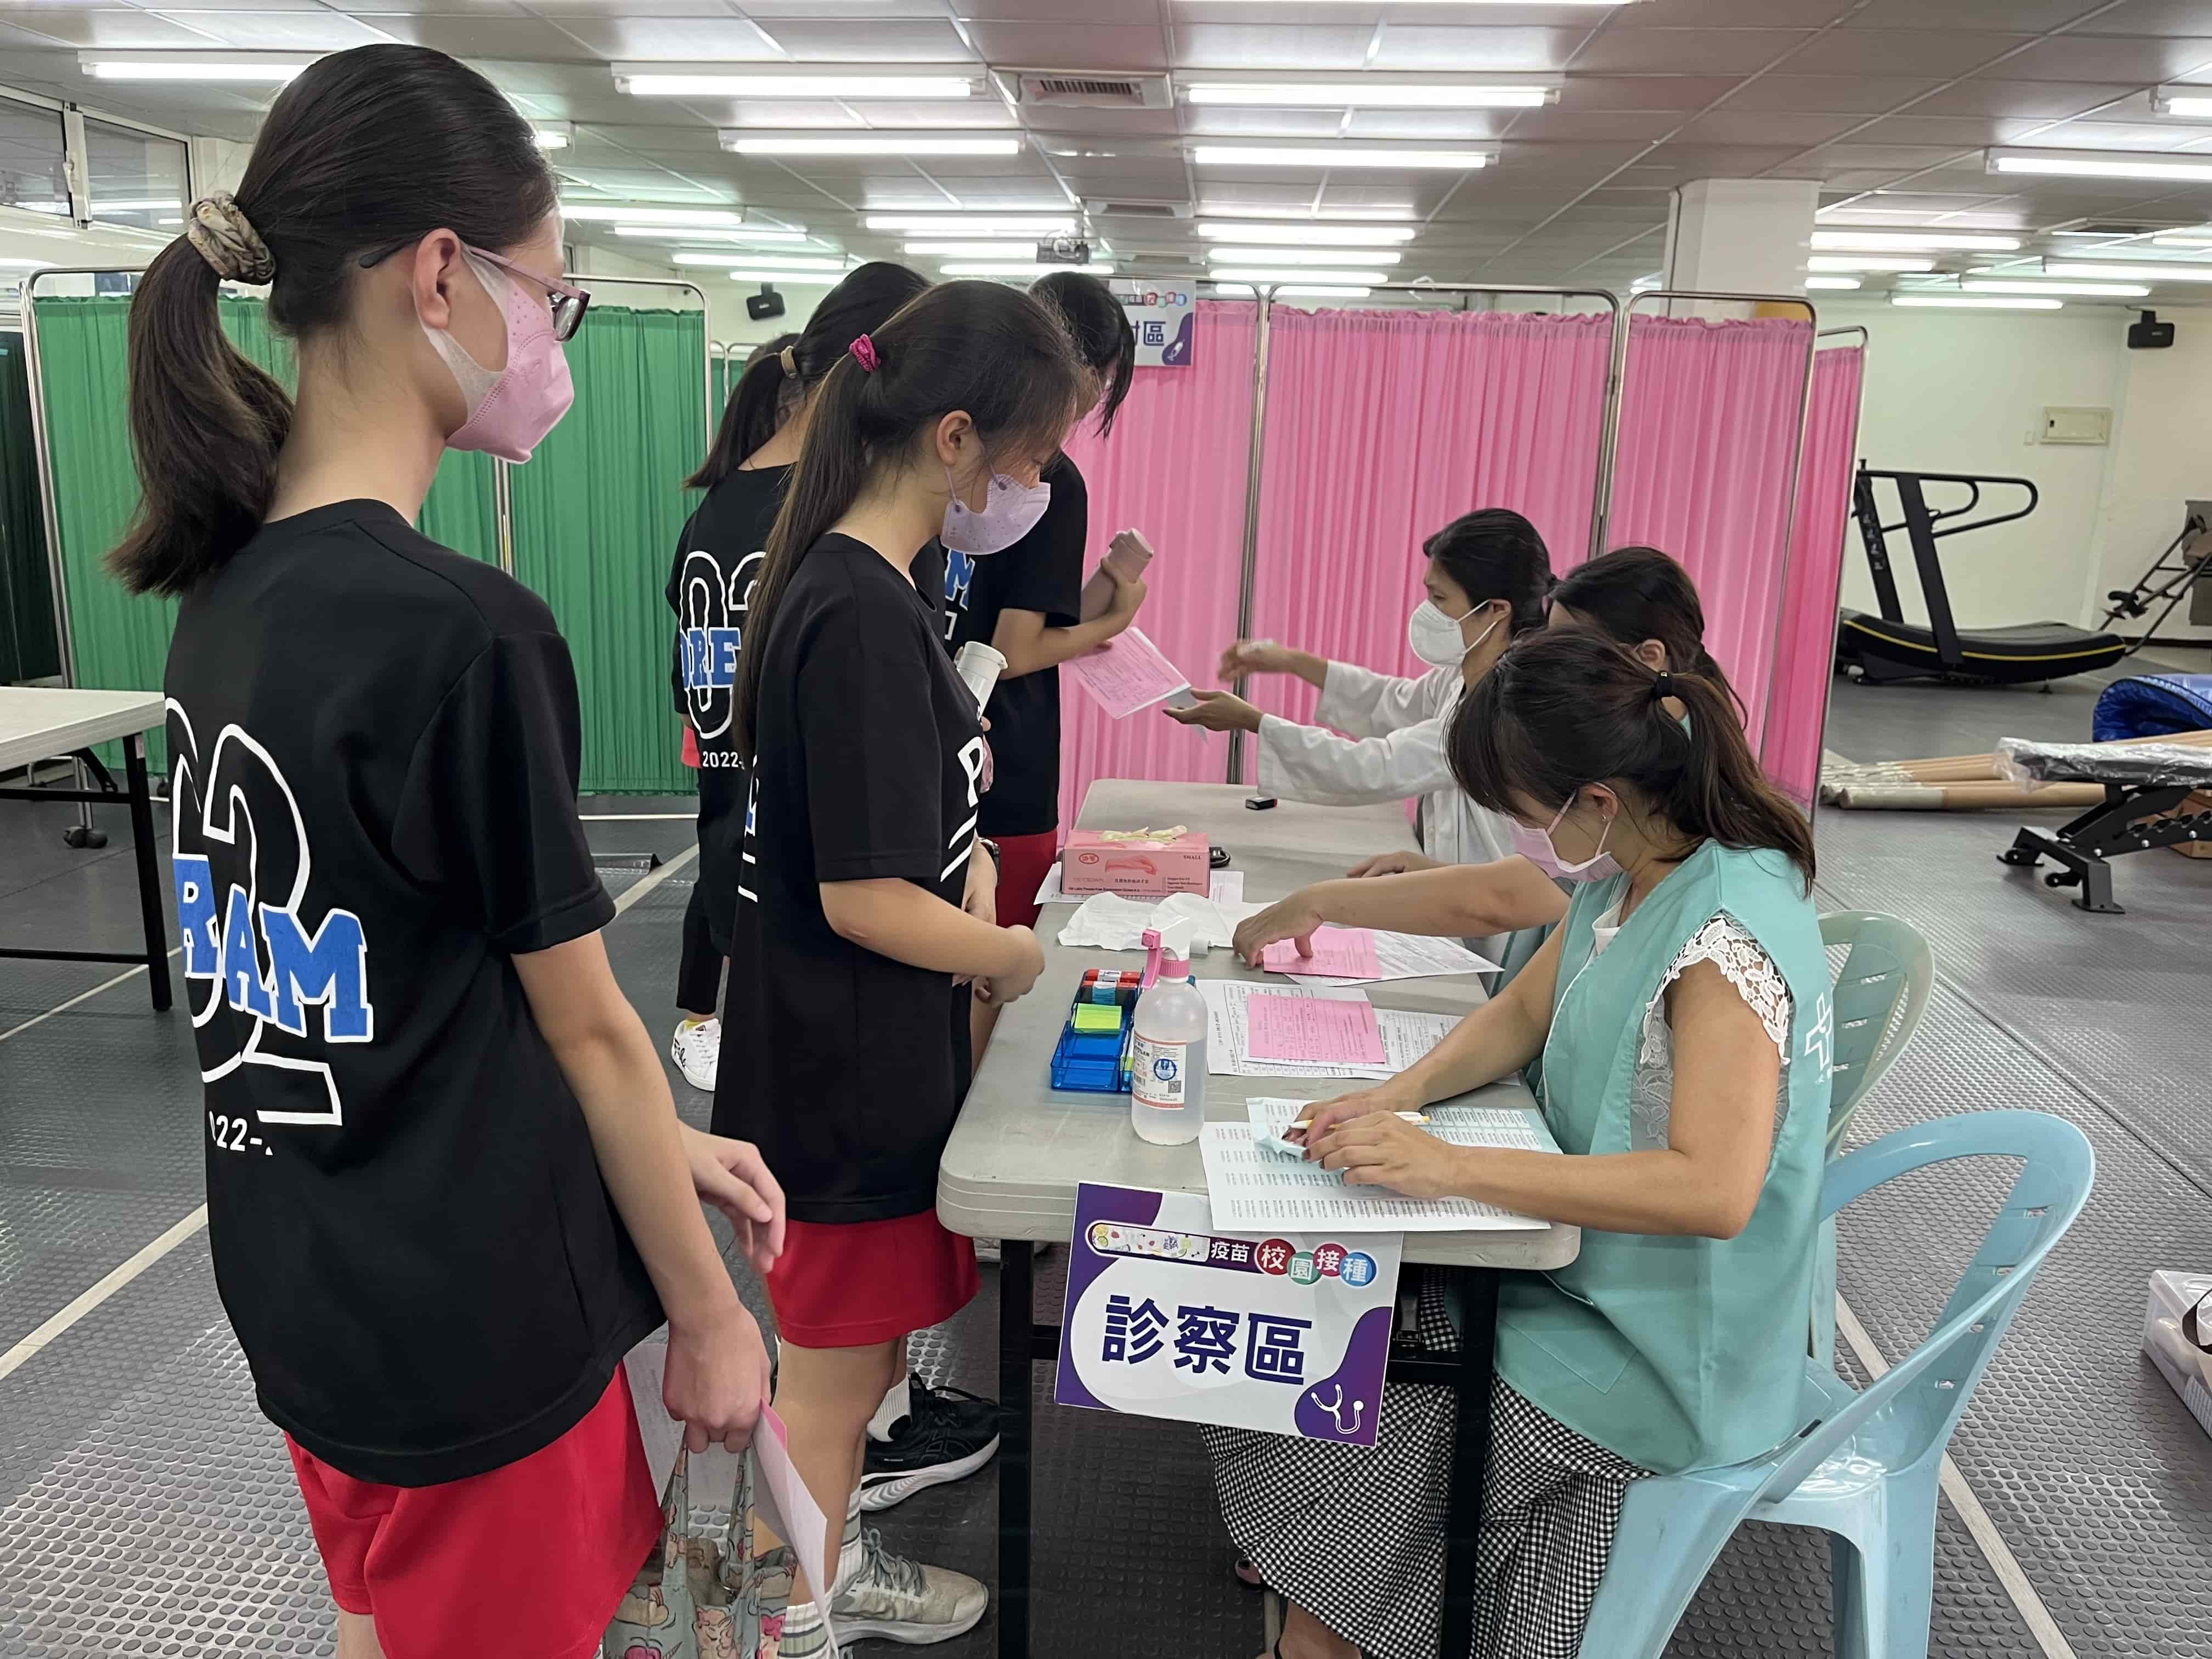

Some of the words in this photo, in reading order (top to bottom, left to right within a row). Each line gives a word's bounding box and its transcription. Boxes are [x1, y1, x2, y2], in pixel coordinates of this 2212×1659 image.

[1211, 1242, 1369, 1283] 疫苗校園接種
[1102, 1295, 1312, 1385] 診察區
